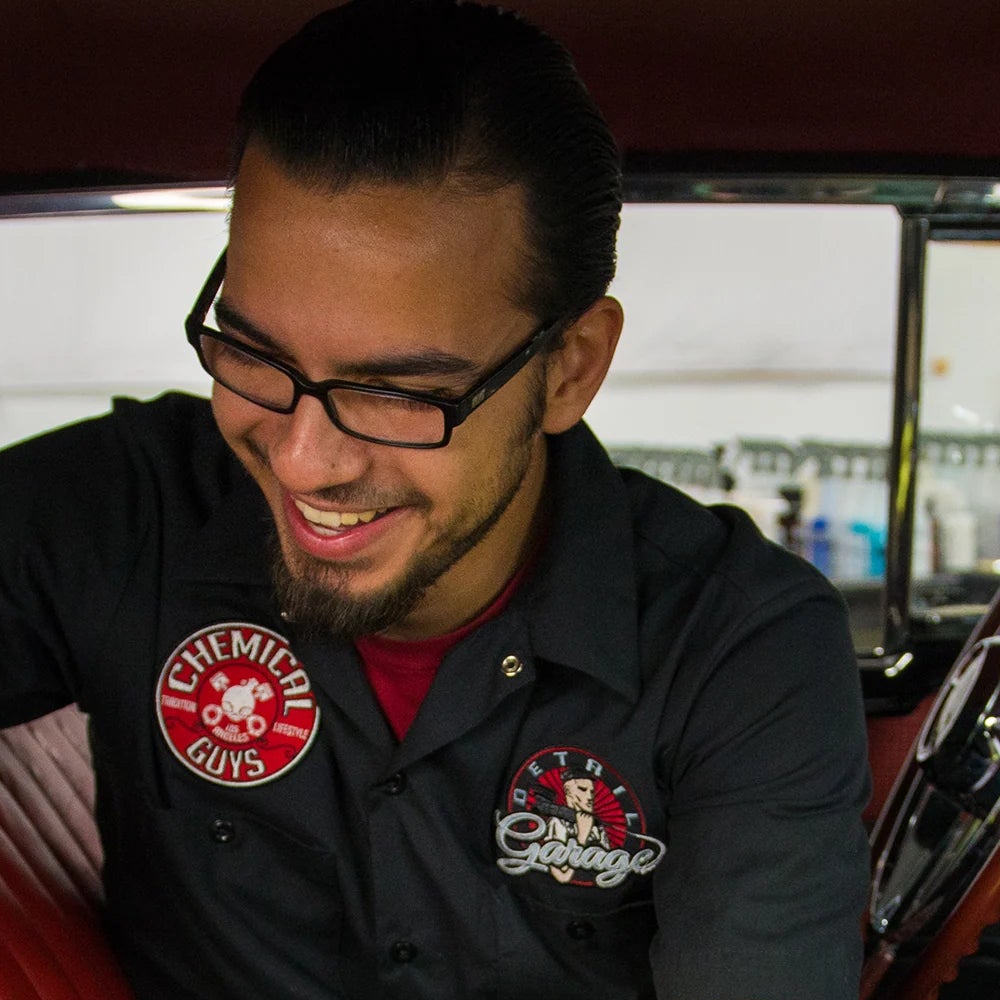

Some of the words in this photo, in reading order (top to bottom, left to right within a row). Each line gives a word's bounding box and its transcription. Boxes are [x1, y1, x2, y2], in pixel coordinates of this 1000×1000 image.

[167, 629, 313, 717] CHEMICAL
[186, 736, 266, 779] GUYS
[512, 750, 639, 827] DETAIL
[495, 808, 667, 889] Garage
